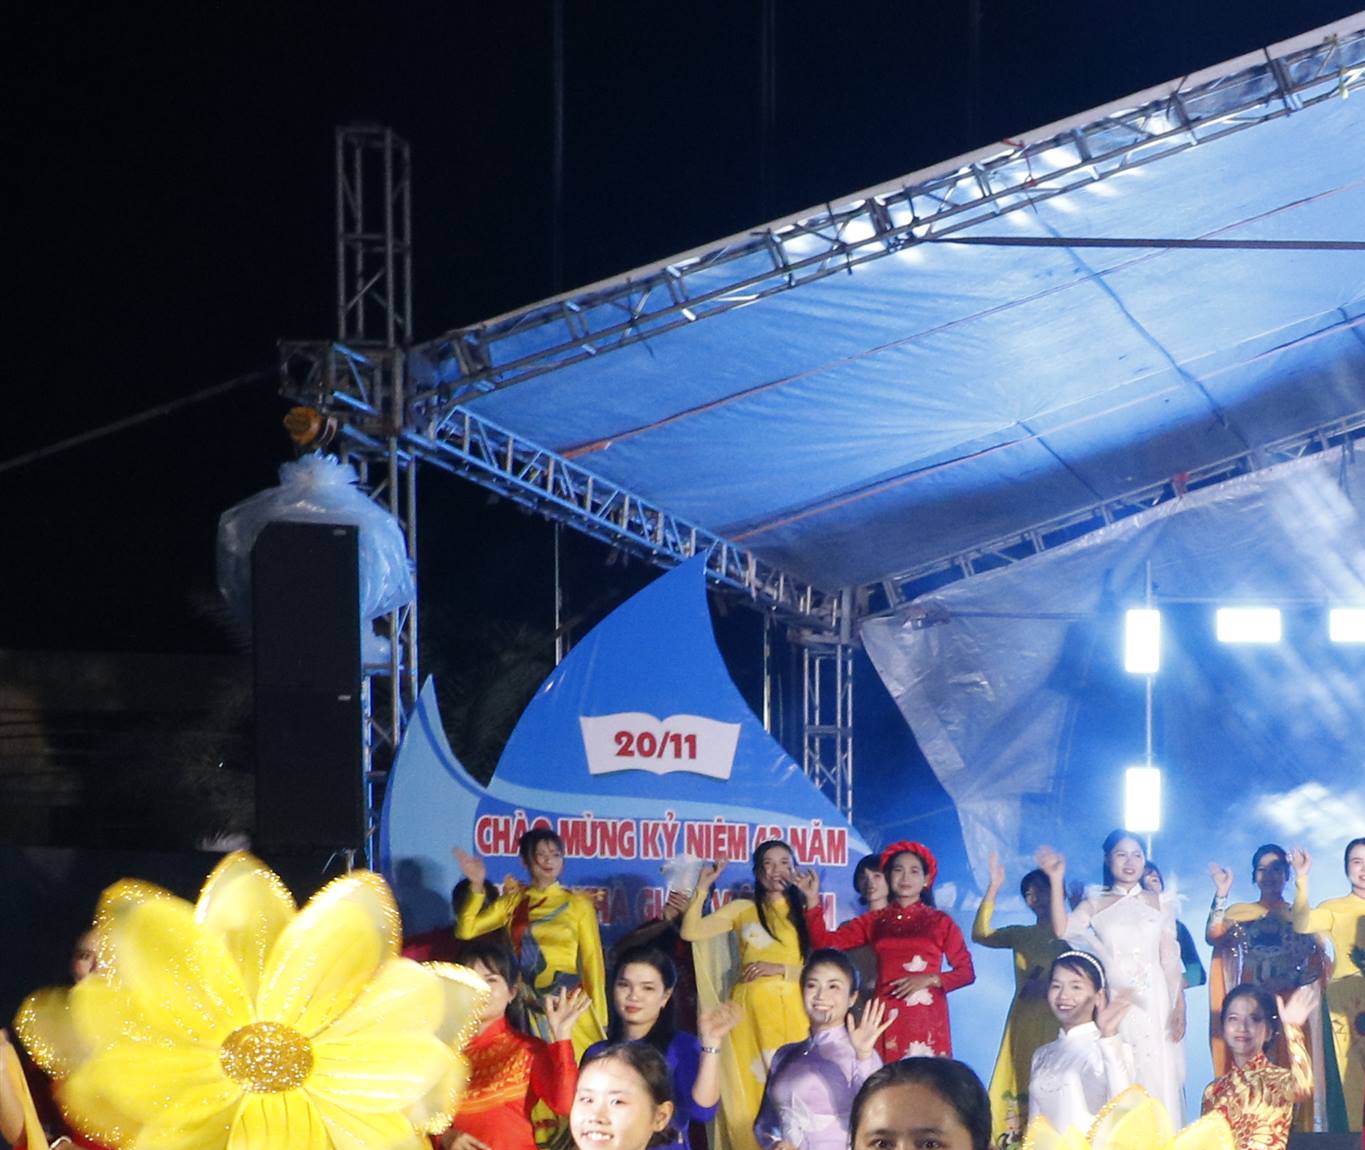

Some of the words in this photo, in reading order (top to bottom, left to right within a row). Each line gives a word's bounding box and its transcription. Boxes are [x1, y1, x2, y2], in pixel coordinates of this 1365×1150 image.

[614, 730, 697, 760] 20/11
[558, 812, 636, 859] MỪNG
[641, 810, 680, 860] KỶ
[788, 819, 848, 867] NĂM
